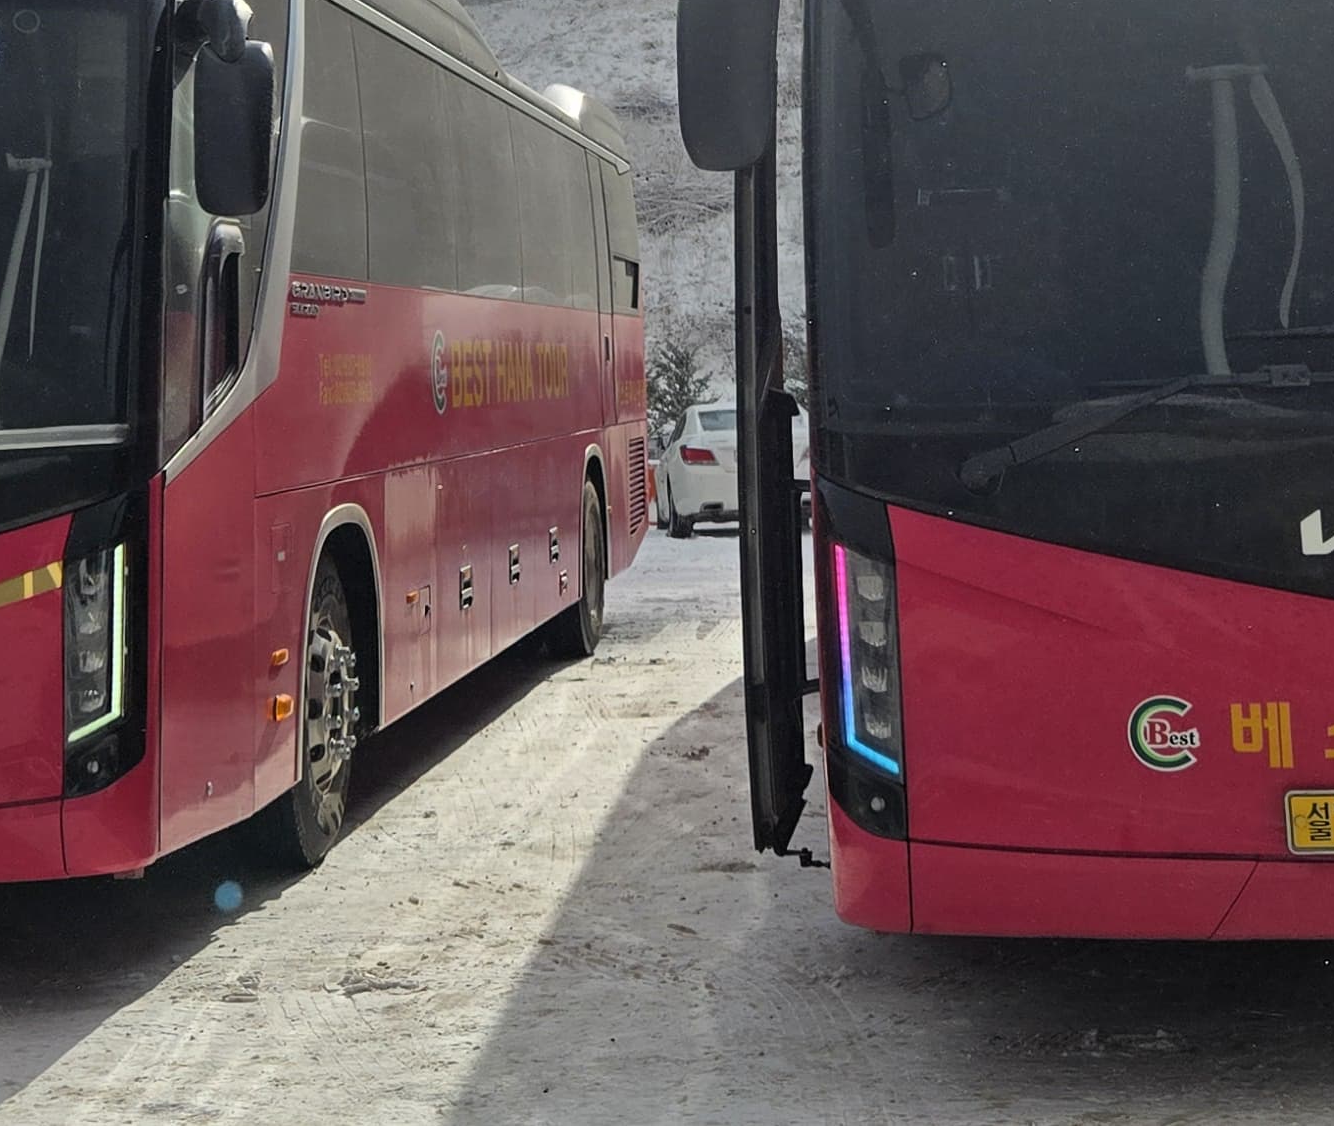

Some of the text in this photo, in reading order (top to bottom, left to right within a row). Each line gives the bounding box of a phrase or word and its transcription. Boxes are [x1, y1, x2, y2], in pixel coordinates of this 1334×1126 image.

[451, 339, 492, 408] BEST
[496, 340, 535, 403] HANA
[536, 343, 570, 399] TOUR
